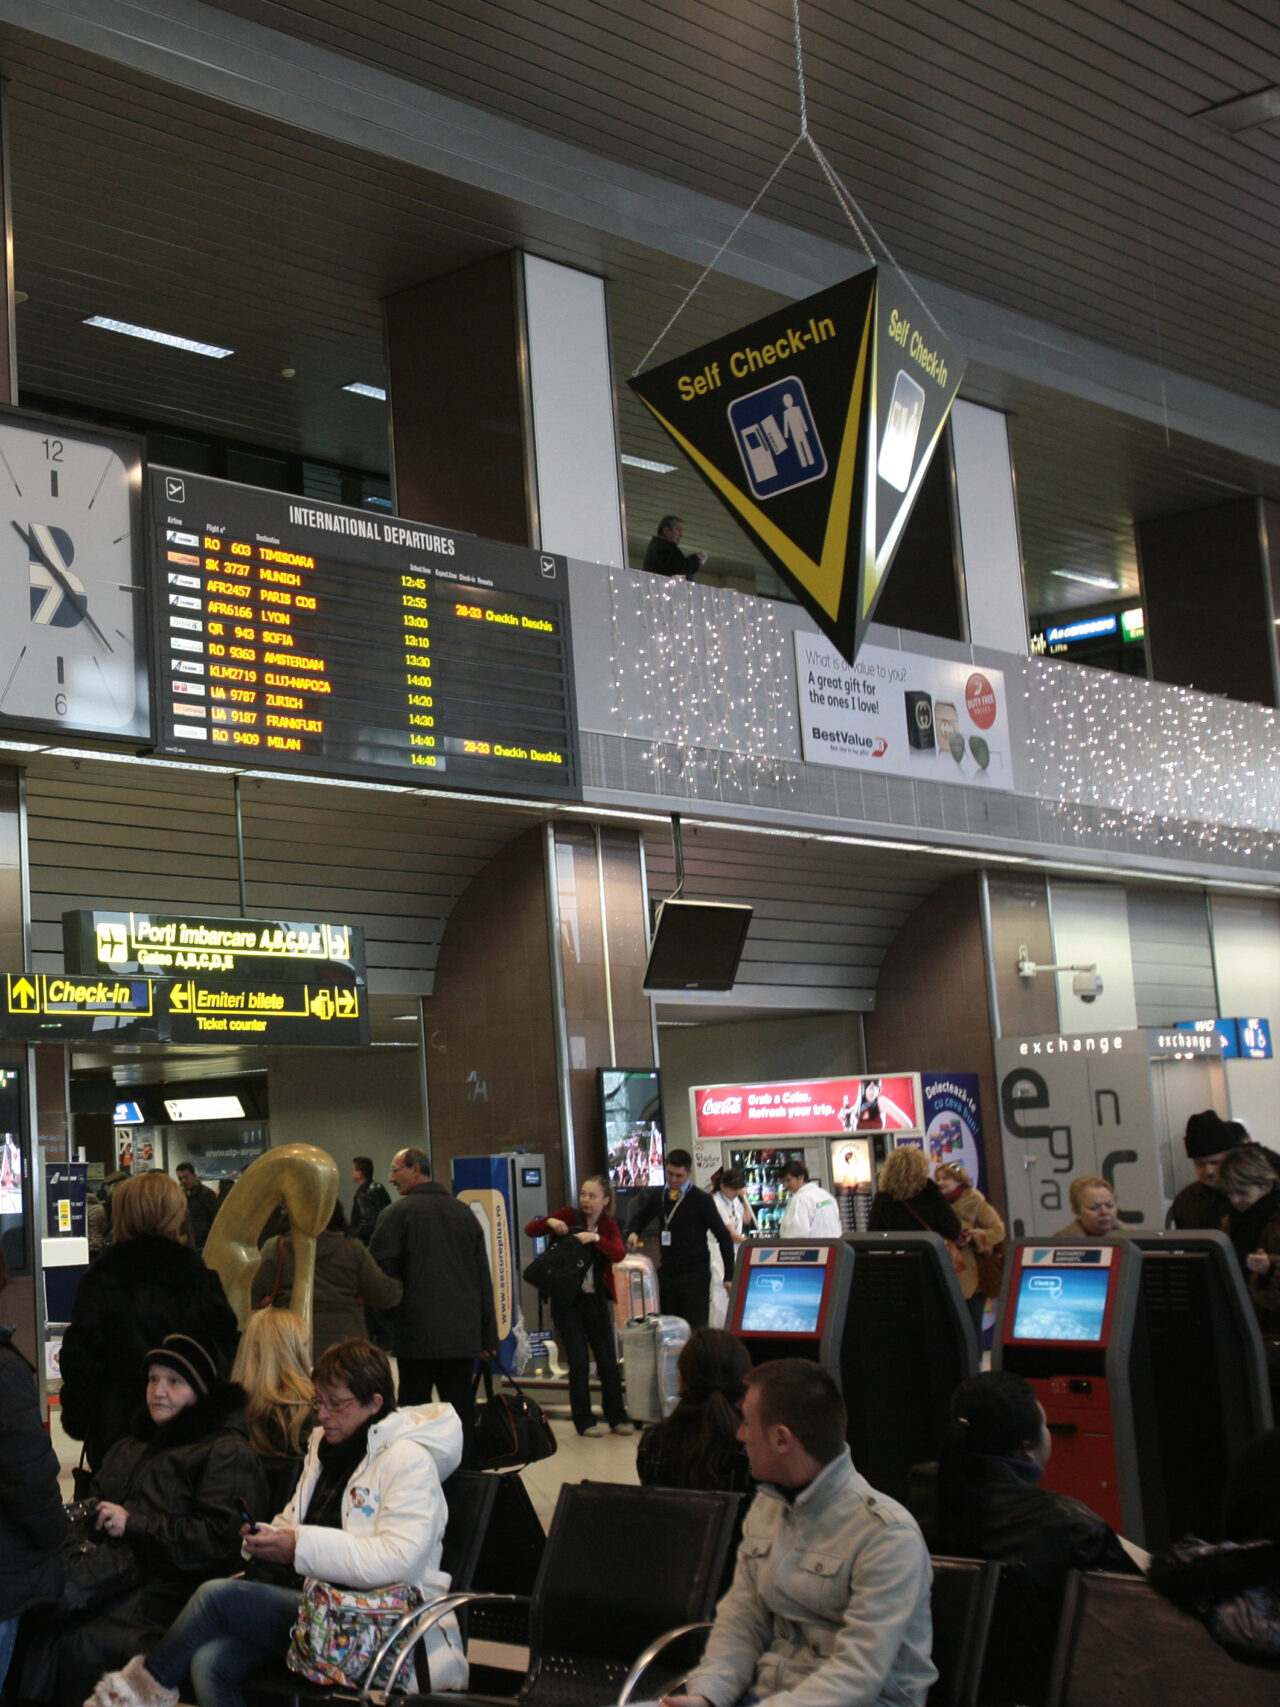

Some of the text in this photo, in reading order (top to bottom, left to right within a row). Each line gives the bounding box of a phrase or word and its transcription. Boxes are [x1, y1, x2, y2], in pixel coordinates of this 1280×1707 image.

[889, 308, 948, 388] Self Check-In
[678, 317, 836, 402] Self Check-In
[42, 439, 63, 462] 12
[289, 505, 455, 556] INTERNATIONAL DEPARTURES
[204, 537, 314, 568] RO TIMISOARA
[260, 569, 300, 586] MUNICH
[261, 590, 291, 605] PARIS
[262, 610, 290, 625] LYON
[262, 631, 293, 646] SOFIA
[209, 644, 224, 656] RO
[264, 652, 324, 671] AMSTERDAM
[806, 649, 906, 683] What is to you?
[808, 670, 875, 696] A great gift for
[55, 694, 67, 716] 6
[266, 694, 303, 709] ZURICH
[809, 690, 879, 714] the ones I love!
[267, 715, 323, 732] FRANKFURT
[268, 736, 300, 750] MILAN
[812, 727, 873, 748] BestValue
[138, 922, 320, 954] Porți îmbarcare A,B,C,D,E
[175, 954, 234, 970] A,B,C,D,E
[49, 980, 130, 1005] Check-in
[198, 990, 283, 1010] Emiteri bilete
[198, 1018, 267, 1032] Ticket counter
[1195, 1020, 1215, 1032] WC
[1020, 1036, 1122, 1054] exchange
[1159, 1032, 1212, 1052] exchange
[748, 1094, 772, 1105] Grab
[782, 1092, 811, 1103] Coke.
[749, 1104, 835, 1119] Refresh your trip.
